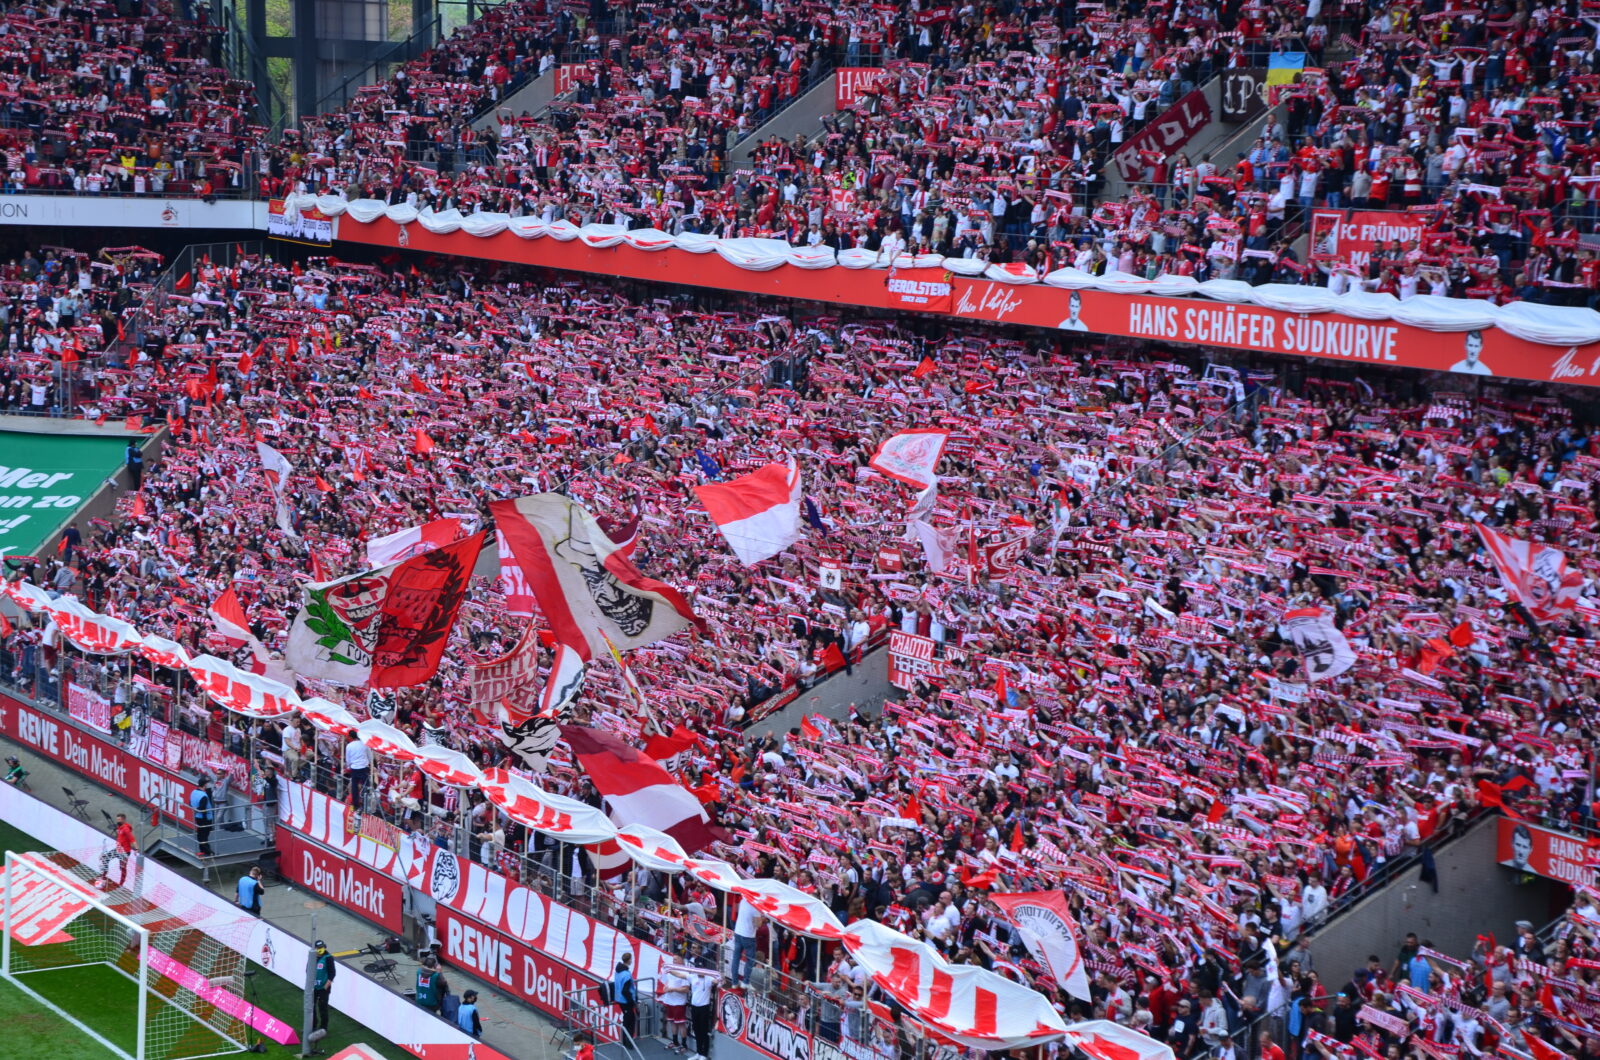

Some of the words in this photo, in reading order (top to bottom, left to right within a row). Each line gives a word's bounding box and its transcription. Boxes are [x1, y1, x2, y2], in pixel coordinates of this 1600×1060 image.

[888, 278, 951, 297] GEROLSTEIN
[1129, 302, 1178, 338] HANS
[1184, 305, 1276, 348] SCHÄFER
[1282, 315, 1399, 361] SÜDKURVE
[32, 495, 81, 508] zo
[19, 708, 58, 755] REWE
[63, 730, 88, 770] Dein
[91, 744, 127, 788] Markt
[139, 766, 185, 820] REWE
[1549, 836, 1584, 862] HANS
[303, 850, 334, 898] Dein
[339, 867, 385, 918] Markt
[448, 917, 513, 986] REWE
[523, 954, 564, 1012] Dein
